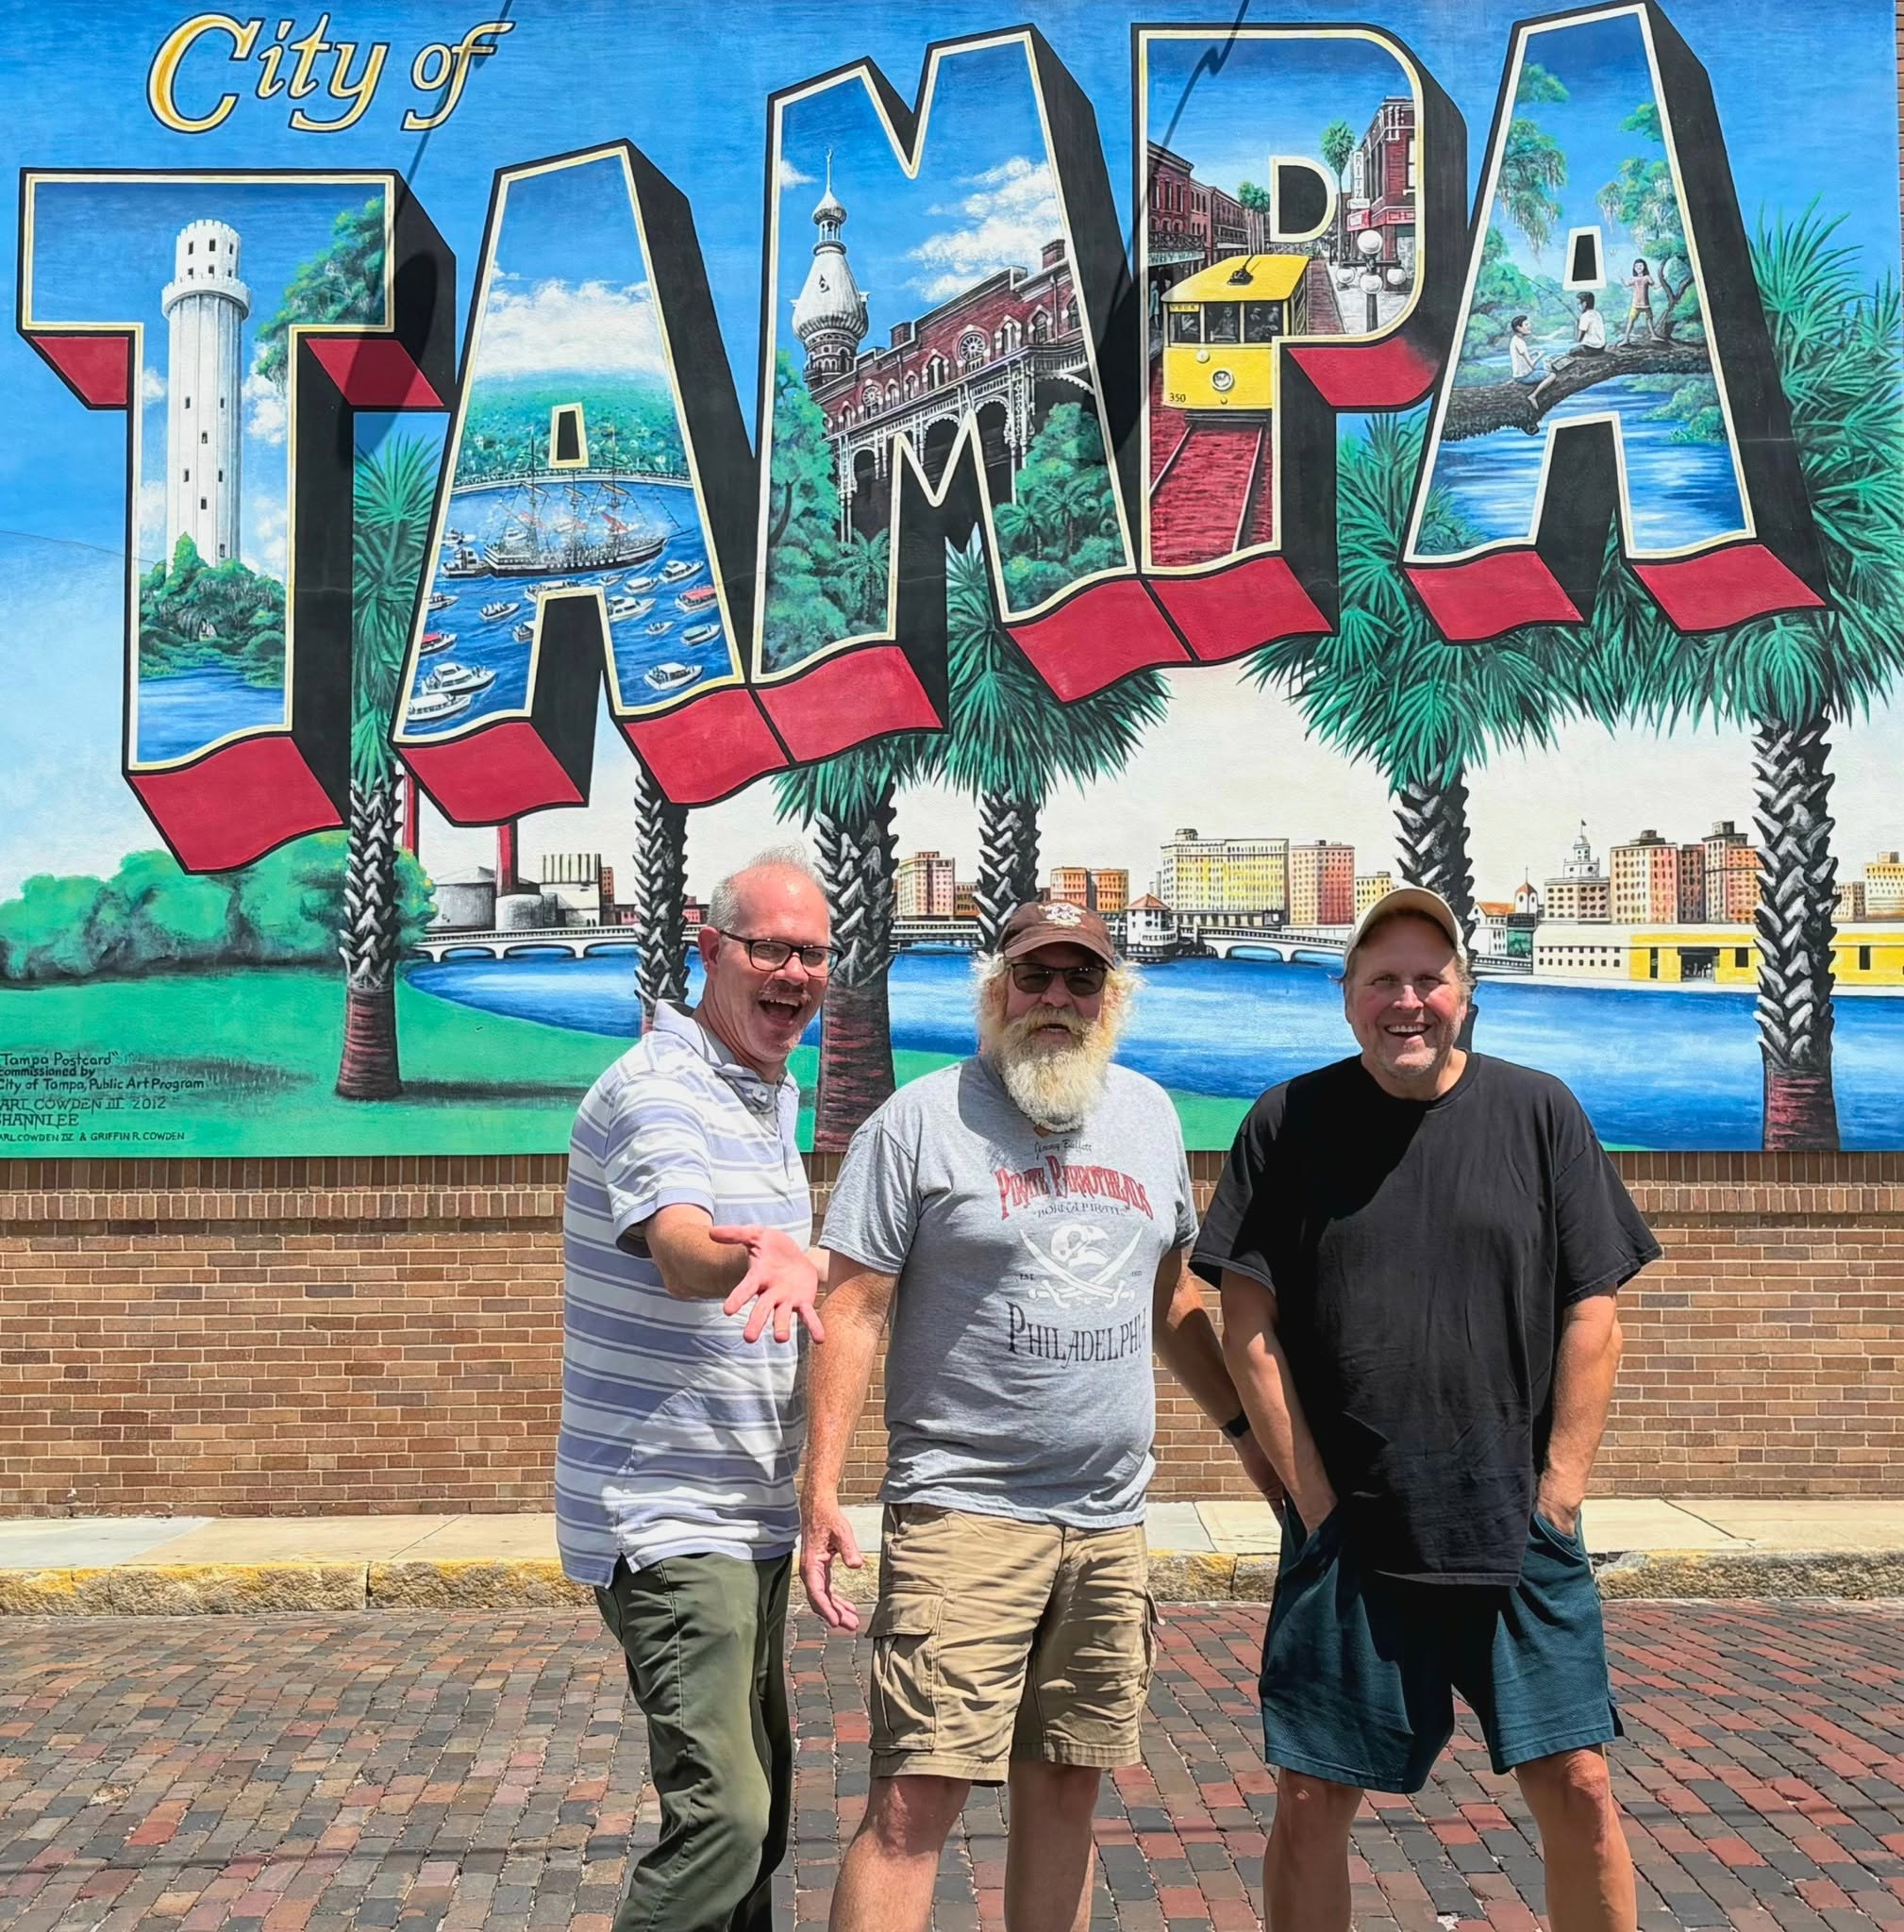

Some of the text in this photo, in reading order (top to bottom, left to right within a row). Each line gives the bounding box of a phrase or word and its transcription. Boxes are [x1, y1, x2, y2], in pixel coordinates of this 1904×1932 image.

[146, 12, 514, 133] City of
[1169, 392, 1187, 403] 350
[19, 3, 1825, 874] TAMPA
[80, 1066, 95, 1079] by
[25, 1078, 39, 1090] of
[89, 1077, 124, 1091] Public
[125, 1075, 149, 1089] Art
[151, 1077, 205, 1092] Program
[0, 1098, 35, 1113] ARL
[34, 1096, 102, 1115] COWDEN
[132, 1095, 167, 1109] 2012
[0, 1113, 79, 1130] HANNLEE
[0, 1133, 16, 1141] ARL
[17, 1133, 58, 1141] COWDEN
[79, 1132, 87, 1141] &
[91, 1132, 130, 1141] GRIFFIN
[142, 1131, 185, 1141] COWDEN
